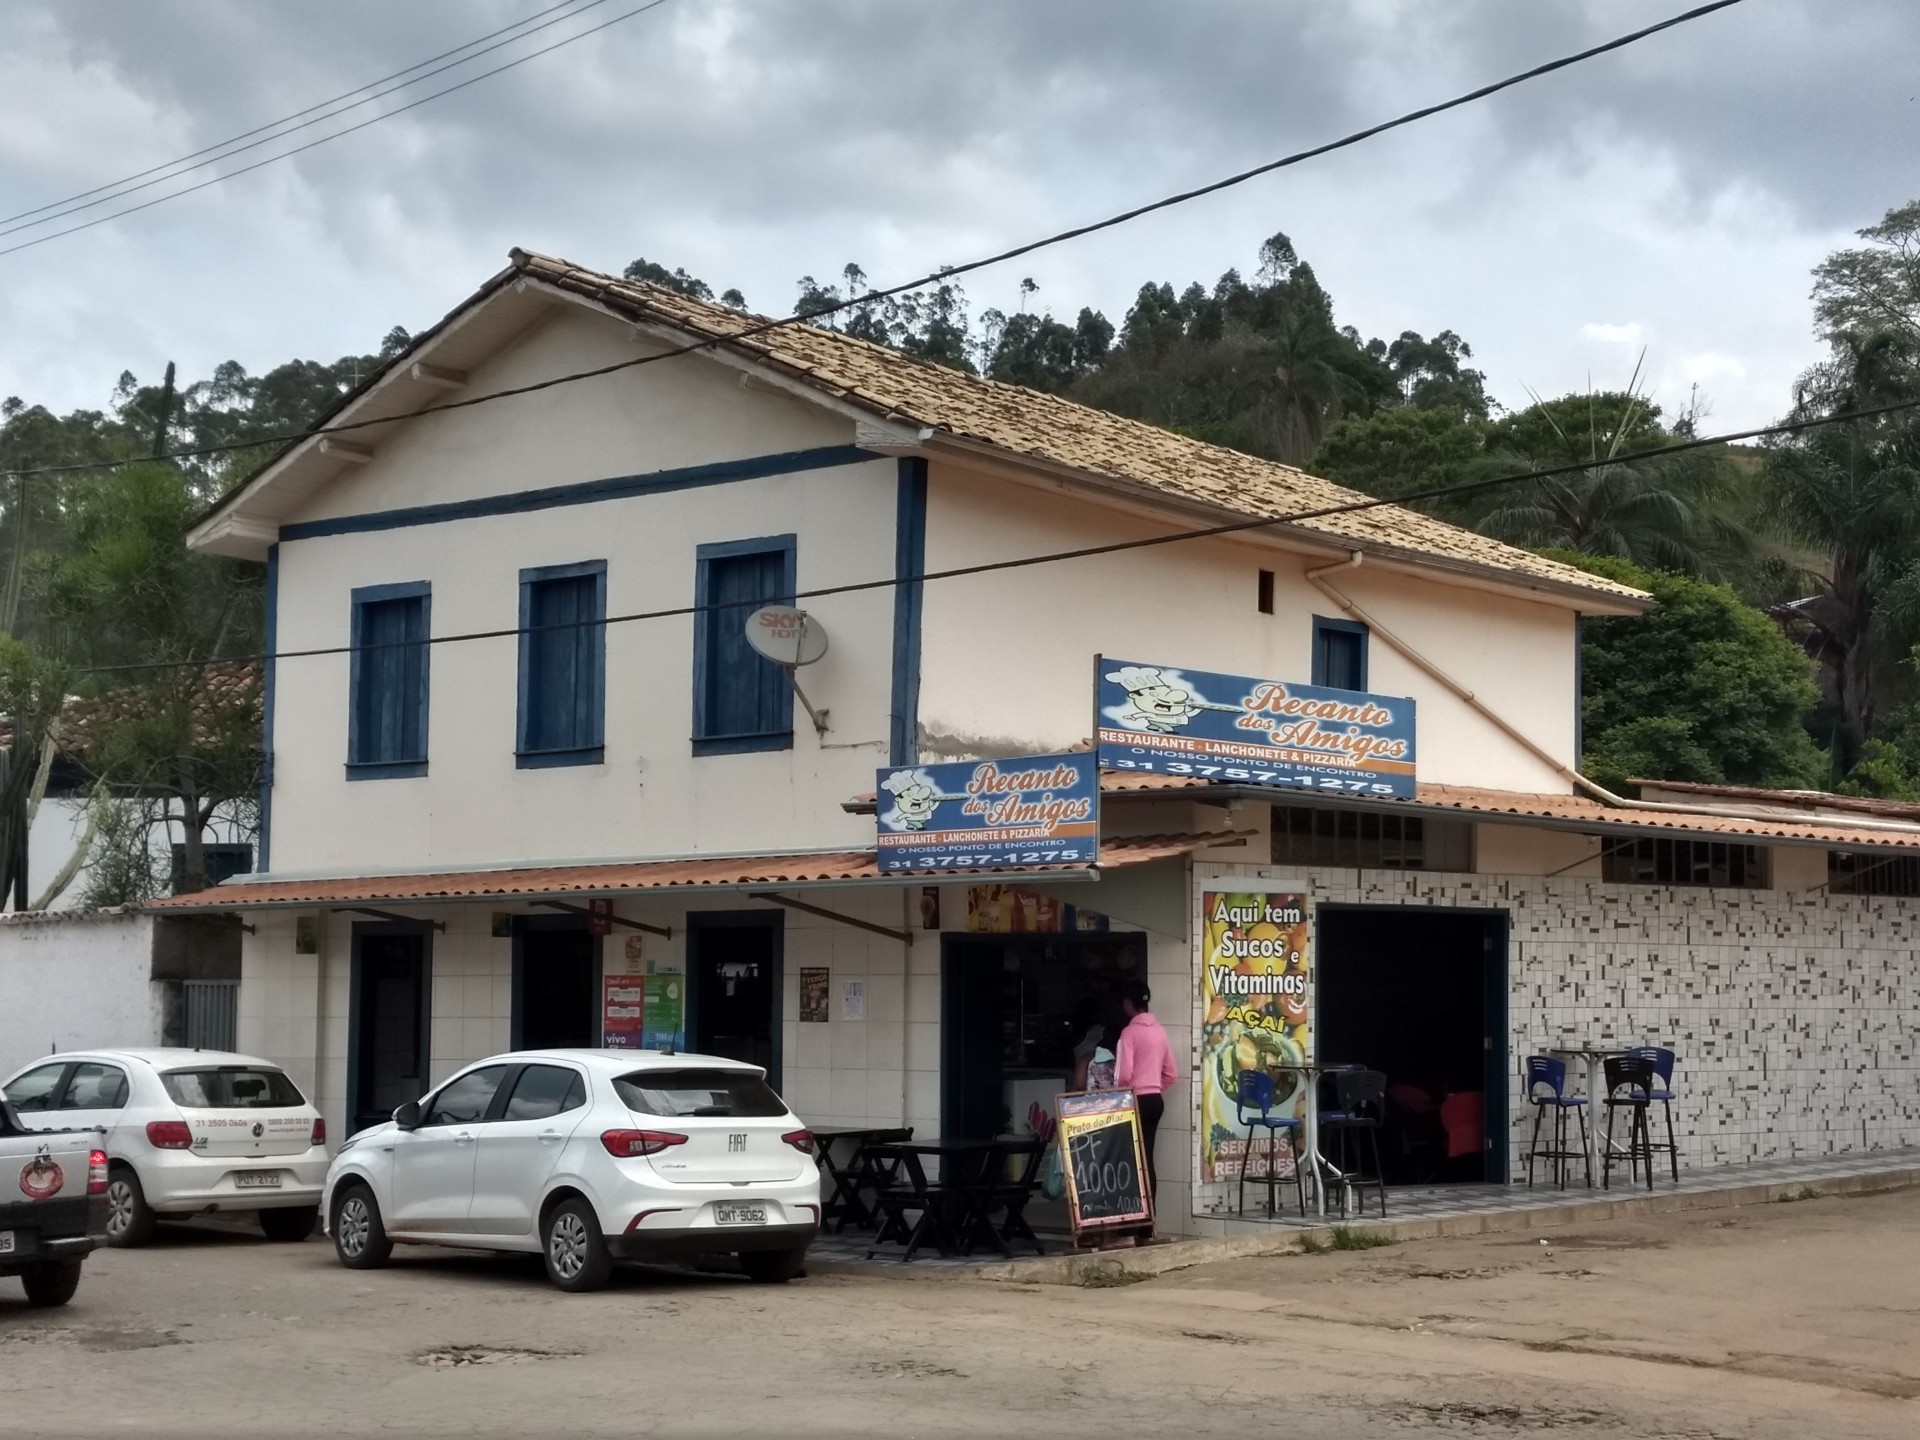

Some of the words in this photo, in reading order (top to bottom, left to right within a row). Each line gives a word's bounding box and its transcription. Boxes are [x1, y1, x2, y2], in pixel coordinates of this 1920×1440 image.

[1244, 684, 1390, 725] Recanto
[1100, 730, 1195, 750] RESTAURANTE
[1204, 742, 1288, 760] LANCHONETE
[1291, 751, 1300, 762] &
[1302, 753, 1357, 768] PIZZARIA
[1238, 714, 1274, 731] dos
[1271, 720, 1405, 761] Amigos
[967, 762, 1078, 795] Recanto
[1116, 758, 1153, 771] 31
[1166, 762, 1394, 795] 3757-1275
[1130, 747, 1146, 755] O
[1150, 748, 1210, 761] NOSSO
[1213, 755, 1269, 768] PONTO
[1272, 761, 1293, 770] DE
[1296, 765, 1378, 779] ENCONTRO
[963, 798, 988, 815] dos
[987, 794, 1090, 829] Amigos
[878, 833, 938, 846] RESTAURANTE
[942, 830, 1000, 843] LANCHONETE
[1001, 830, 1008, 840] &
[1009, 827, 1051, 839] PIZZARIA
[896, 847, 906, 855] O
[908, 846, 946, 854] NOSSO
[948, 844, 986, 852] PONTO
[988, 843, 1003, 851] DE
[1004, 839, 1067, 849] ENCONTRO
[889, 860, 911, 868] 31
[919, 849, 1080, 867] 3757-1275
[1213, 899, 1259, 928] Aqui
[1265, 904, 1301, 923] tem
[1221, 930, 1284, 958] Sucos
[1290, 951, 1299, 963] e
[1208, 965, 1305, 995] Vitaminas
[1226, 1005, 1286, 1034] AÇAÍ
[606, 1033, 626, 1044] vivo
[1067, 1121, 1091, 1135] Prato
[1093, 1118, 1104, 1128] do
[728, 1133, 748, 1152] FIAT
[1070, 1131, 1102, 1163] PF
